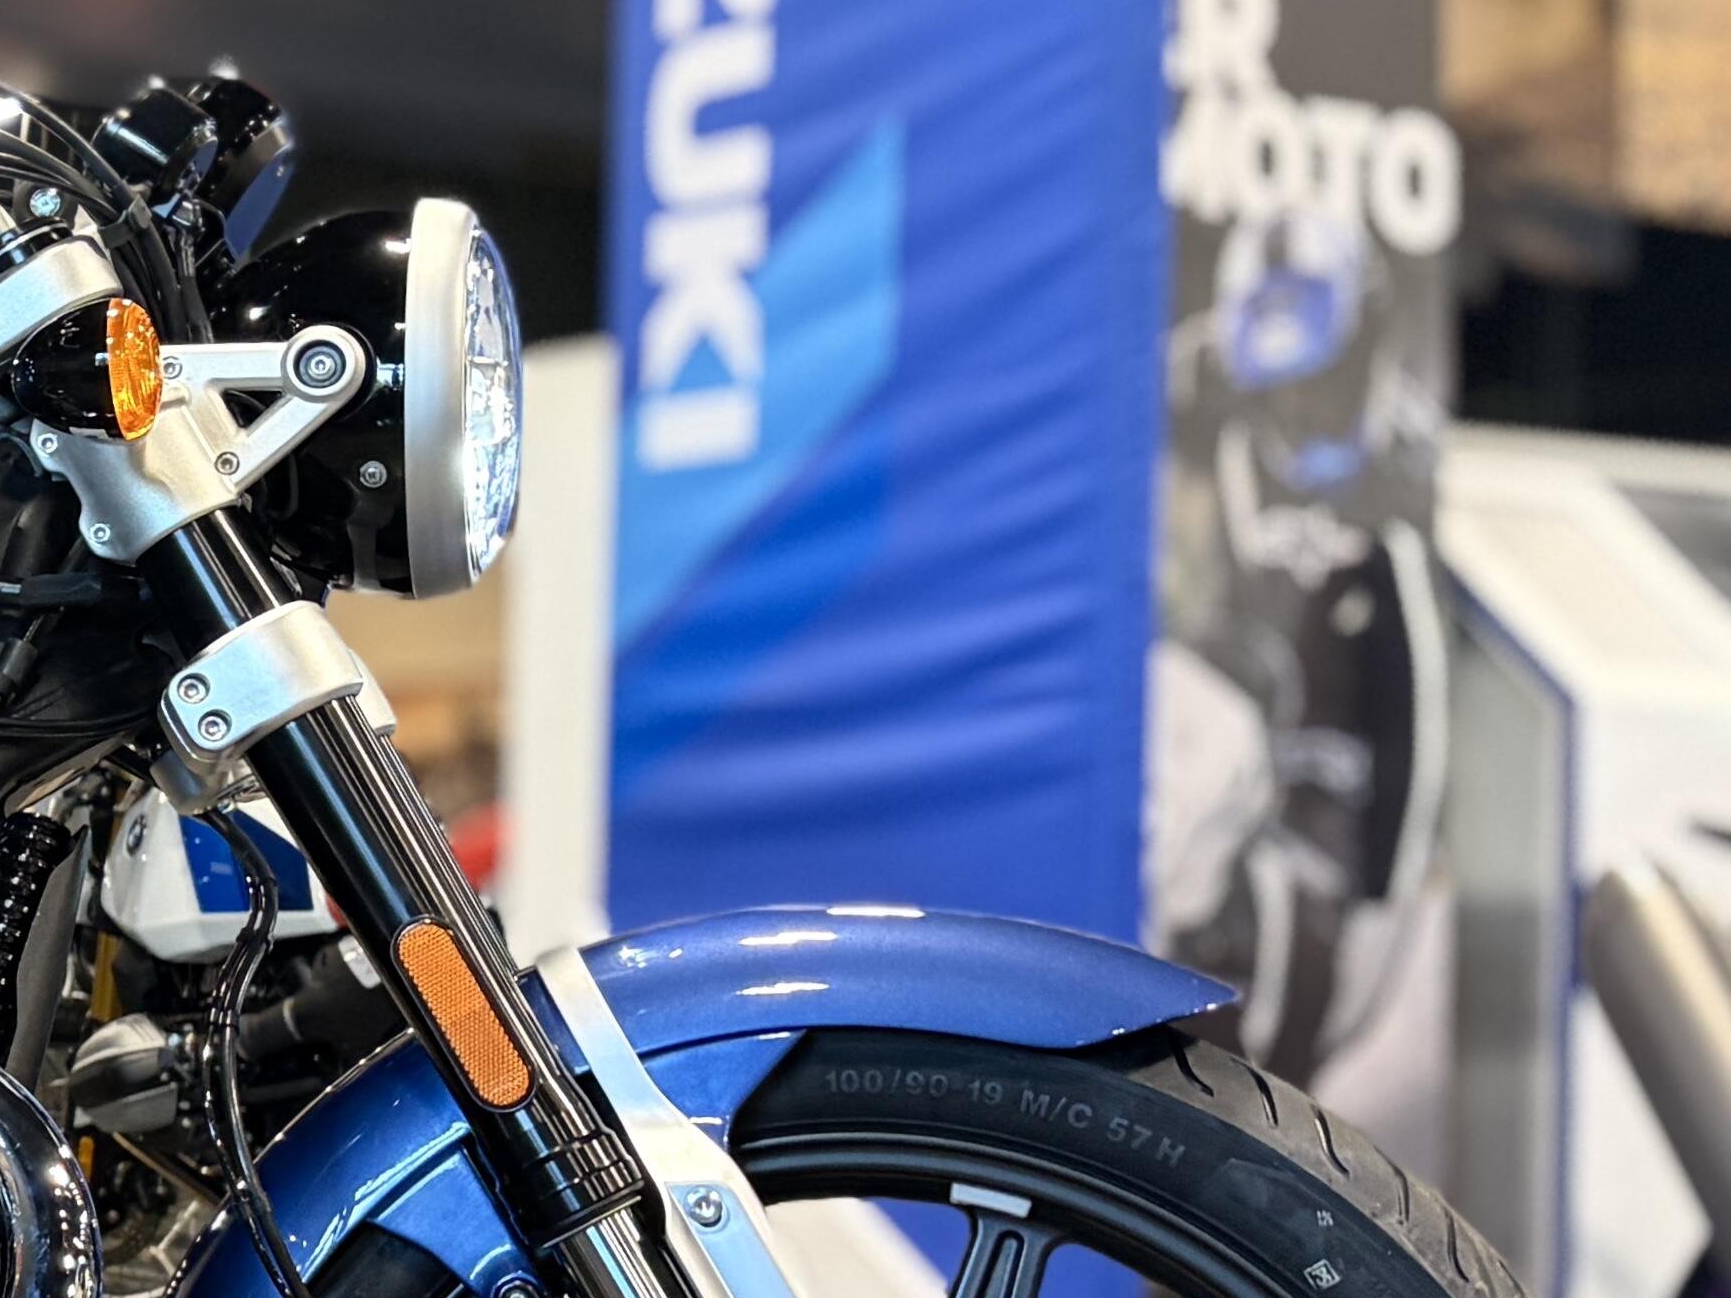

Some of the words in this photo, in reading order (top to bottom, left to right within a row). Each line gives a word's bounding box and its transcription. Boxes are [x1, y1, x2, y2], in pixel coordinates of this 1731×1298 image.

[824, 1068, 949, 1098] 100/90
[967, 1079, 1003, 1105] 19
[1019, 1088, 1094, 1129] M/C
